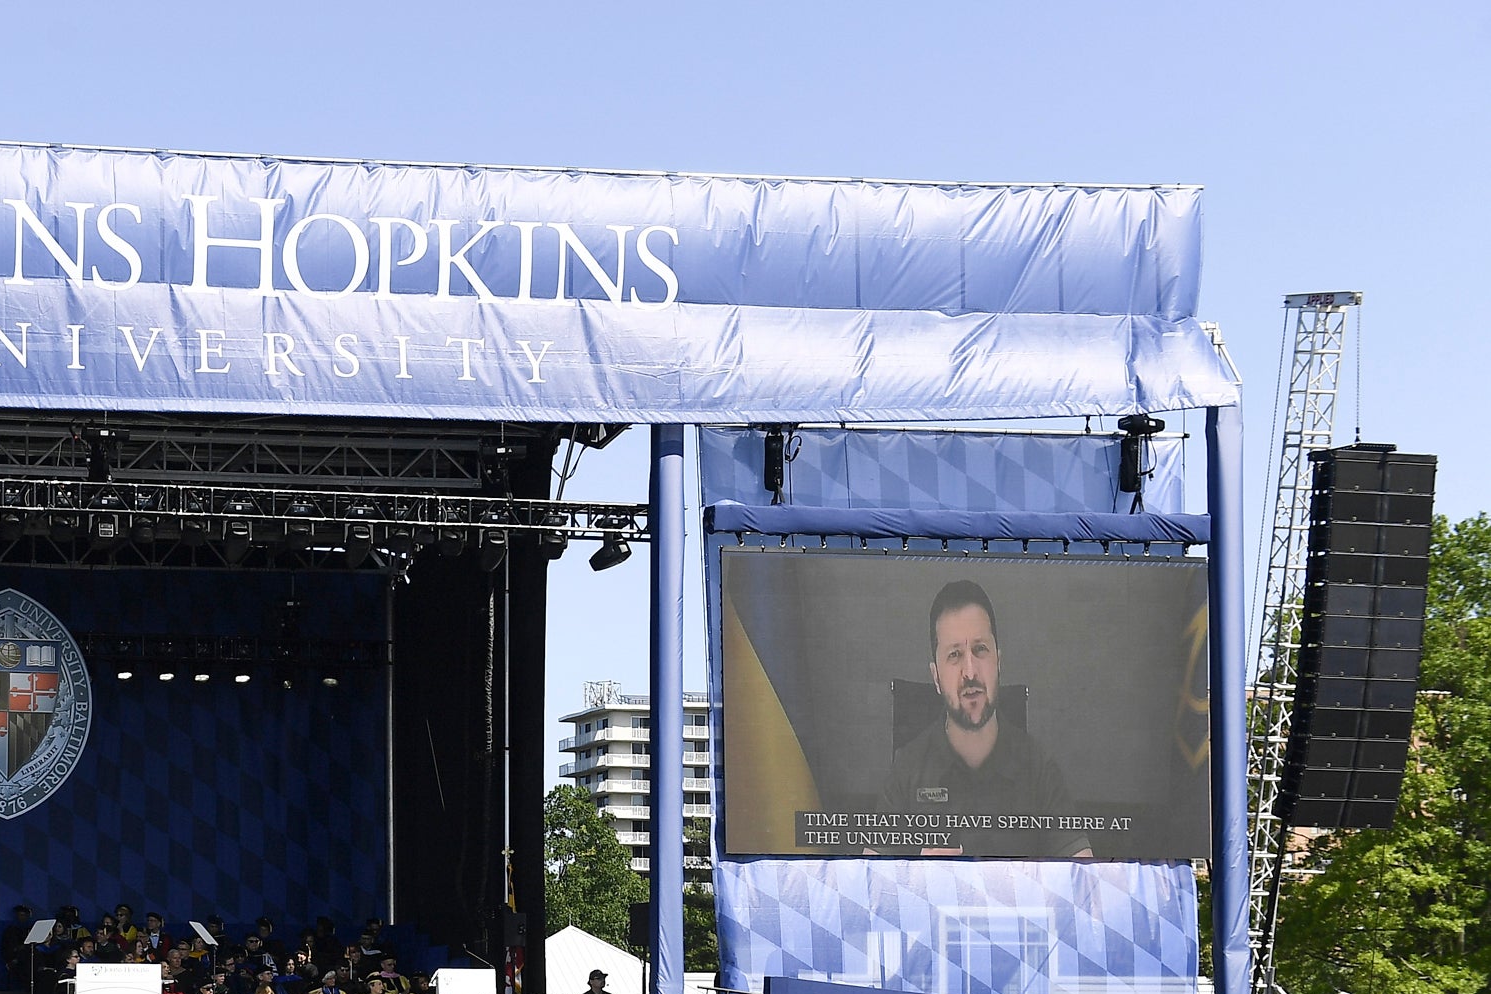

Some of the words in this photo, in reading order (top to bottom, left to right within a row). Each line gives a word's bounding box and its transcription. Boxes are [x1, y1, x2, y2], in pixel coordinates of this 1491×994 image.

[181, 194, 680, 312] HOPKINS
[19, 599, 85, 689] UNIVERSITY
[20, 745, 59, 776] LIBERABIT
[39, 700, 89, 794] BALTIMORE
[804, 813, 848, 827] TIME
[853, 814, 900, 828] THAT
[904, 815, 941, 828] YOU
[945, 815, 992, 829] HAVE
[997, 816, 1054, 830] SPENT
[1058, 816, 1105, 830] HERE
[1109, 817, 1132, 831] AT
[804, 831, 840, 845] THE
[846, 832, 951, 846] UNIVERSITY
